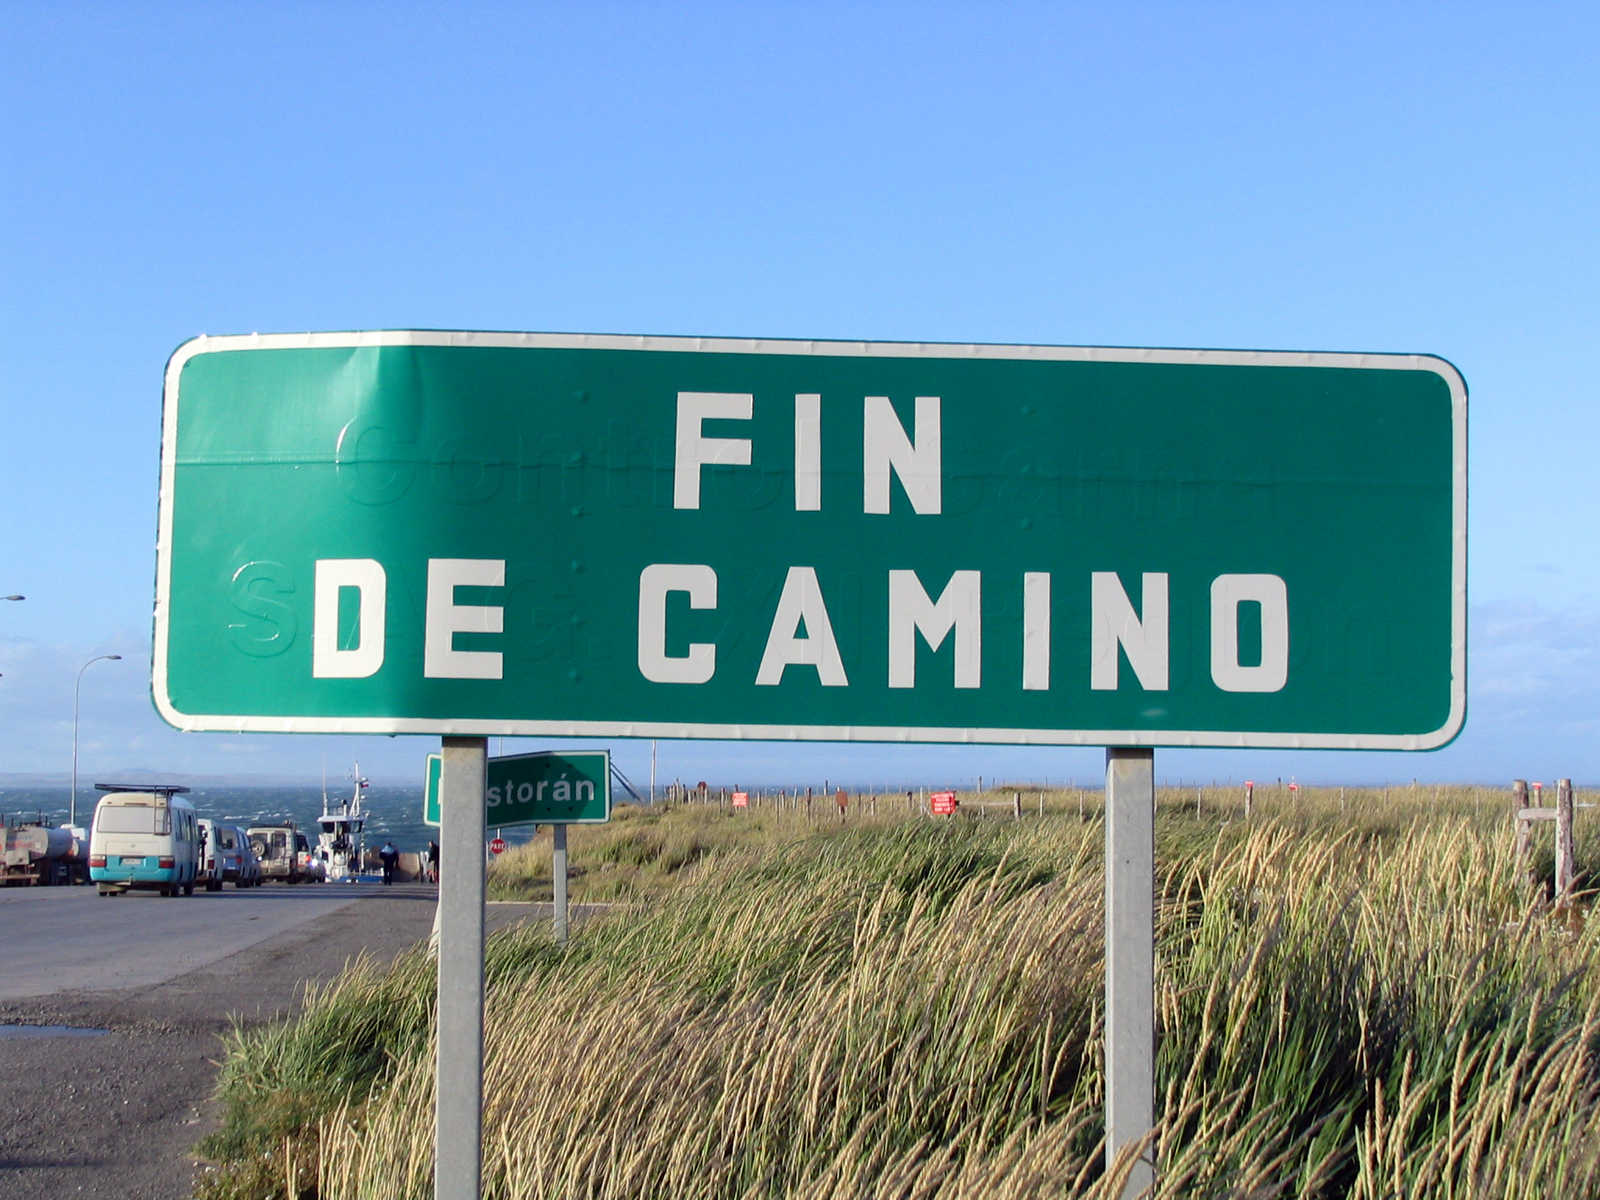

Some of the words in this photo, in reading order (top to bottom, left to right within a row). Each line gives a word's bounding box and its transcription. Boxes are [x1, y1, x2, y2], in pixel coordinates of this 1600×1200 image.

[674, 392, 941, 514] FIN
[313, 559, 505, 679] DE
[639, 564, 1288, 692] CAMINO
[437, 773, 595, 807] storán
